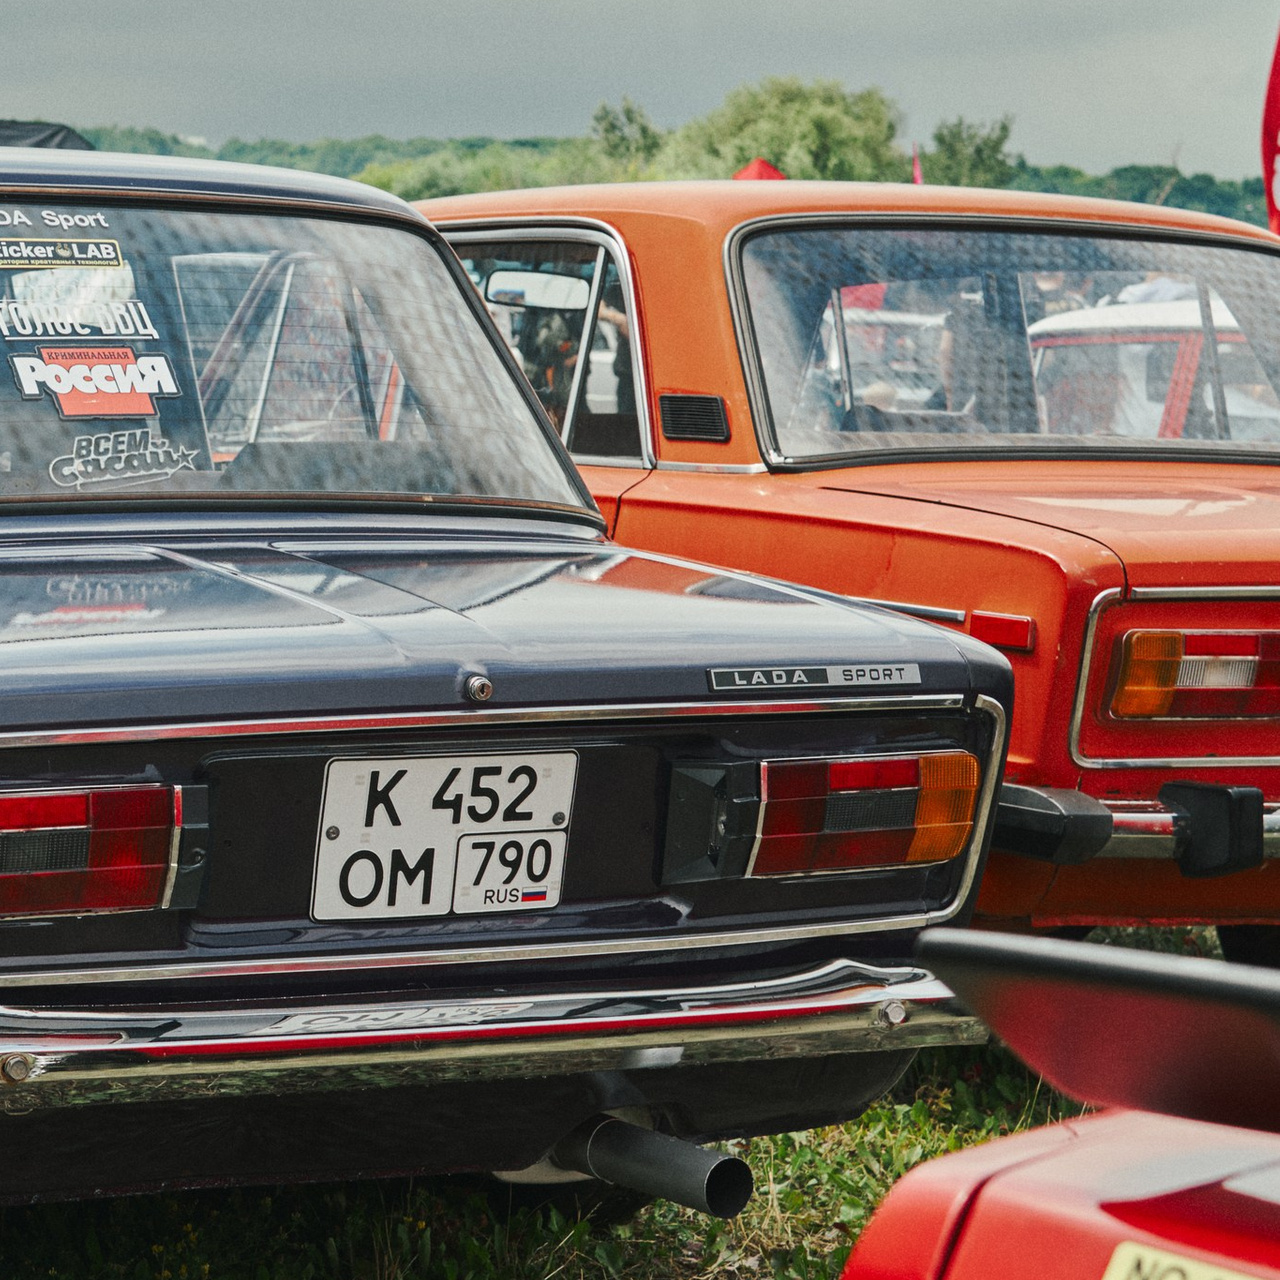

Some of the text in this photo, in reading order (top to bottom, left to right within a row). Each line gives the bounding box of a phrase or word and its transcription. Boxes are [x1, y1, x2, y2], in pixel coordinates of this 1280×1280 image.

[41, 210, 109, 230] Sport
[71, 243, 116, 259] LAB
[46, 351, 130, 361] КРИМИНАЛЬНАЯ
[74, 428, 152, 460] ВСЕМ
[734, 668, 904, 685] LADA SPORT
[365, 765, 538, 827] K 452
[472, 839, 552, 886] 790
[339, 848, 435, 908] OM
[483, 888, 519, 904] RUS
